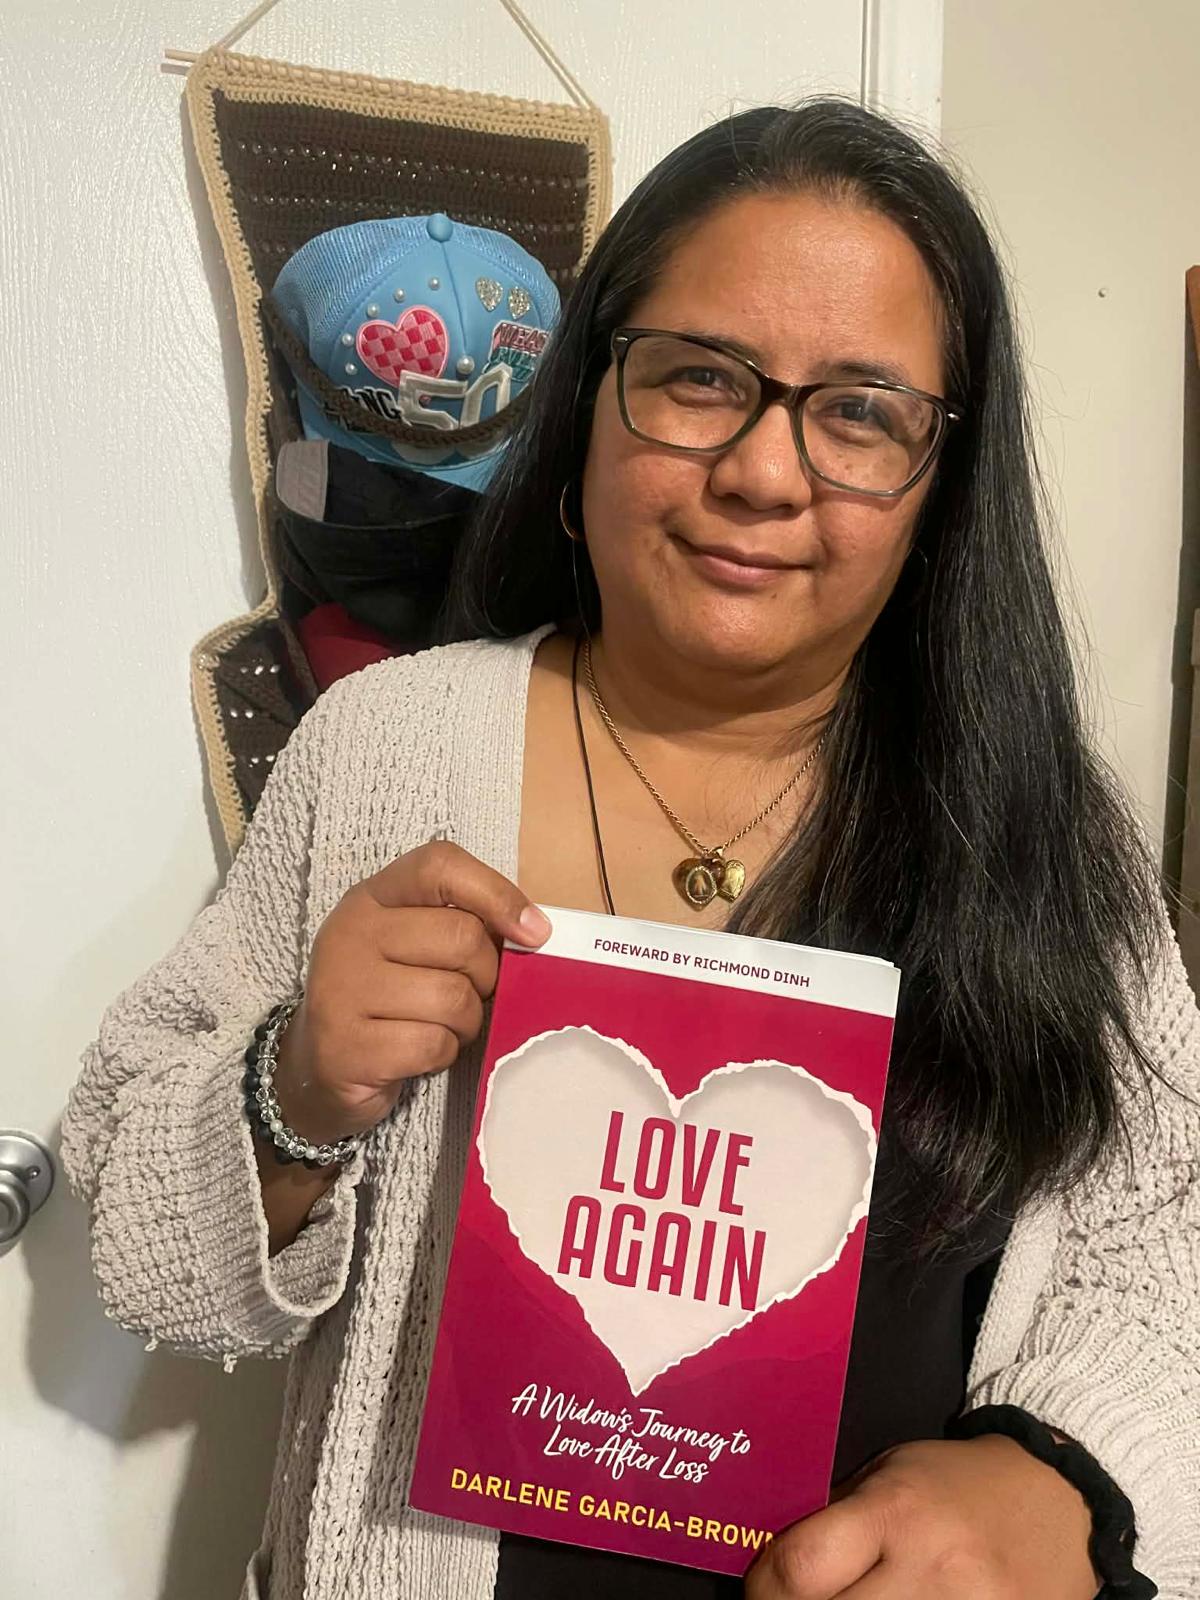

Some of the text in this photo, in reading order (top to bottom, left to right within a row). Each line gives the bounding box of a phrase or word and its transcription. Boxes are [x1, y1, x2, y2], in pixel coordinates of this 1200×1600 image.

[593, 938, 811, 988] FOREWARD BY RICHMOND DINH
[600, 1110, 753, 1216] LOVE
[557, 1195, 766, 1312] AGAIN
[511, 1383, 751, 1462] A Widow's Journey to
[543, 1423, 710, 1483] Love After Loss
[451, 1468, 571, 1512] DARLENE
